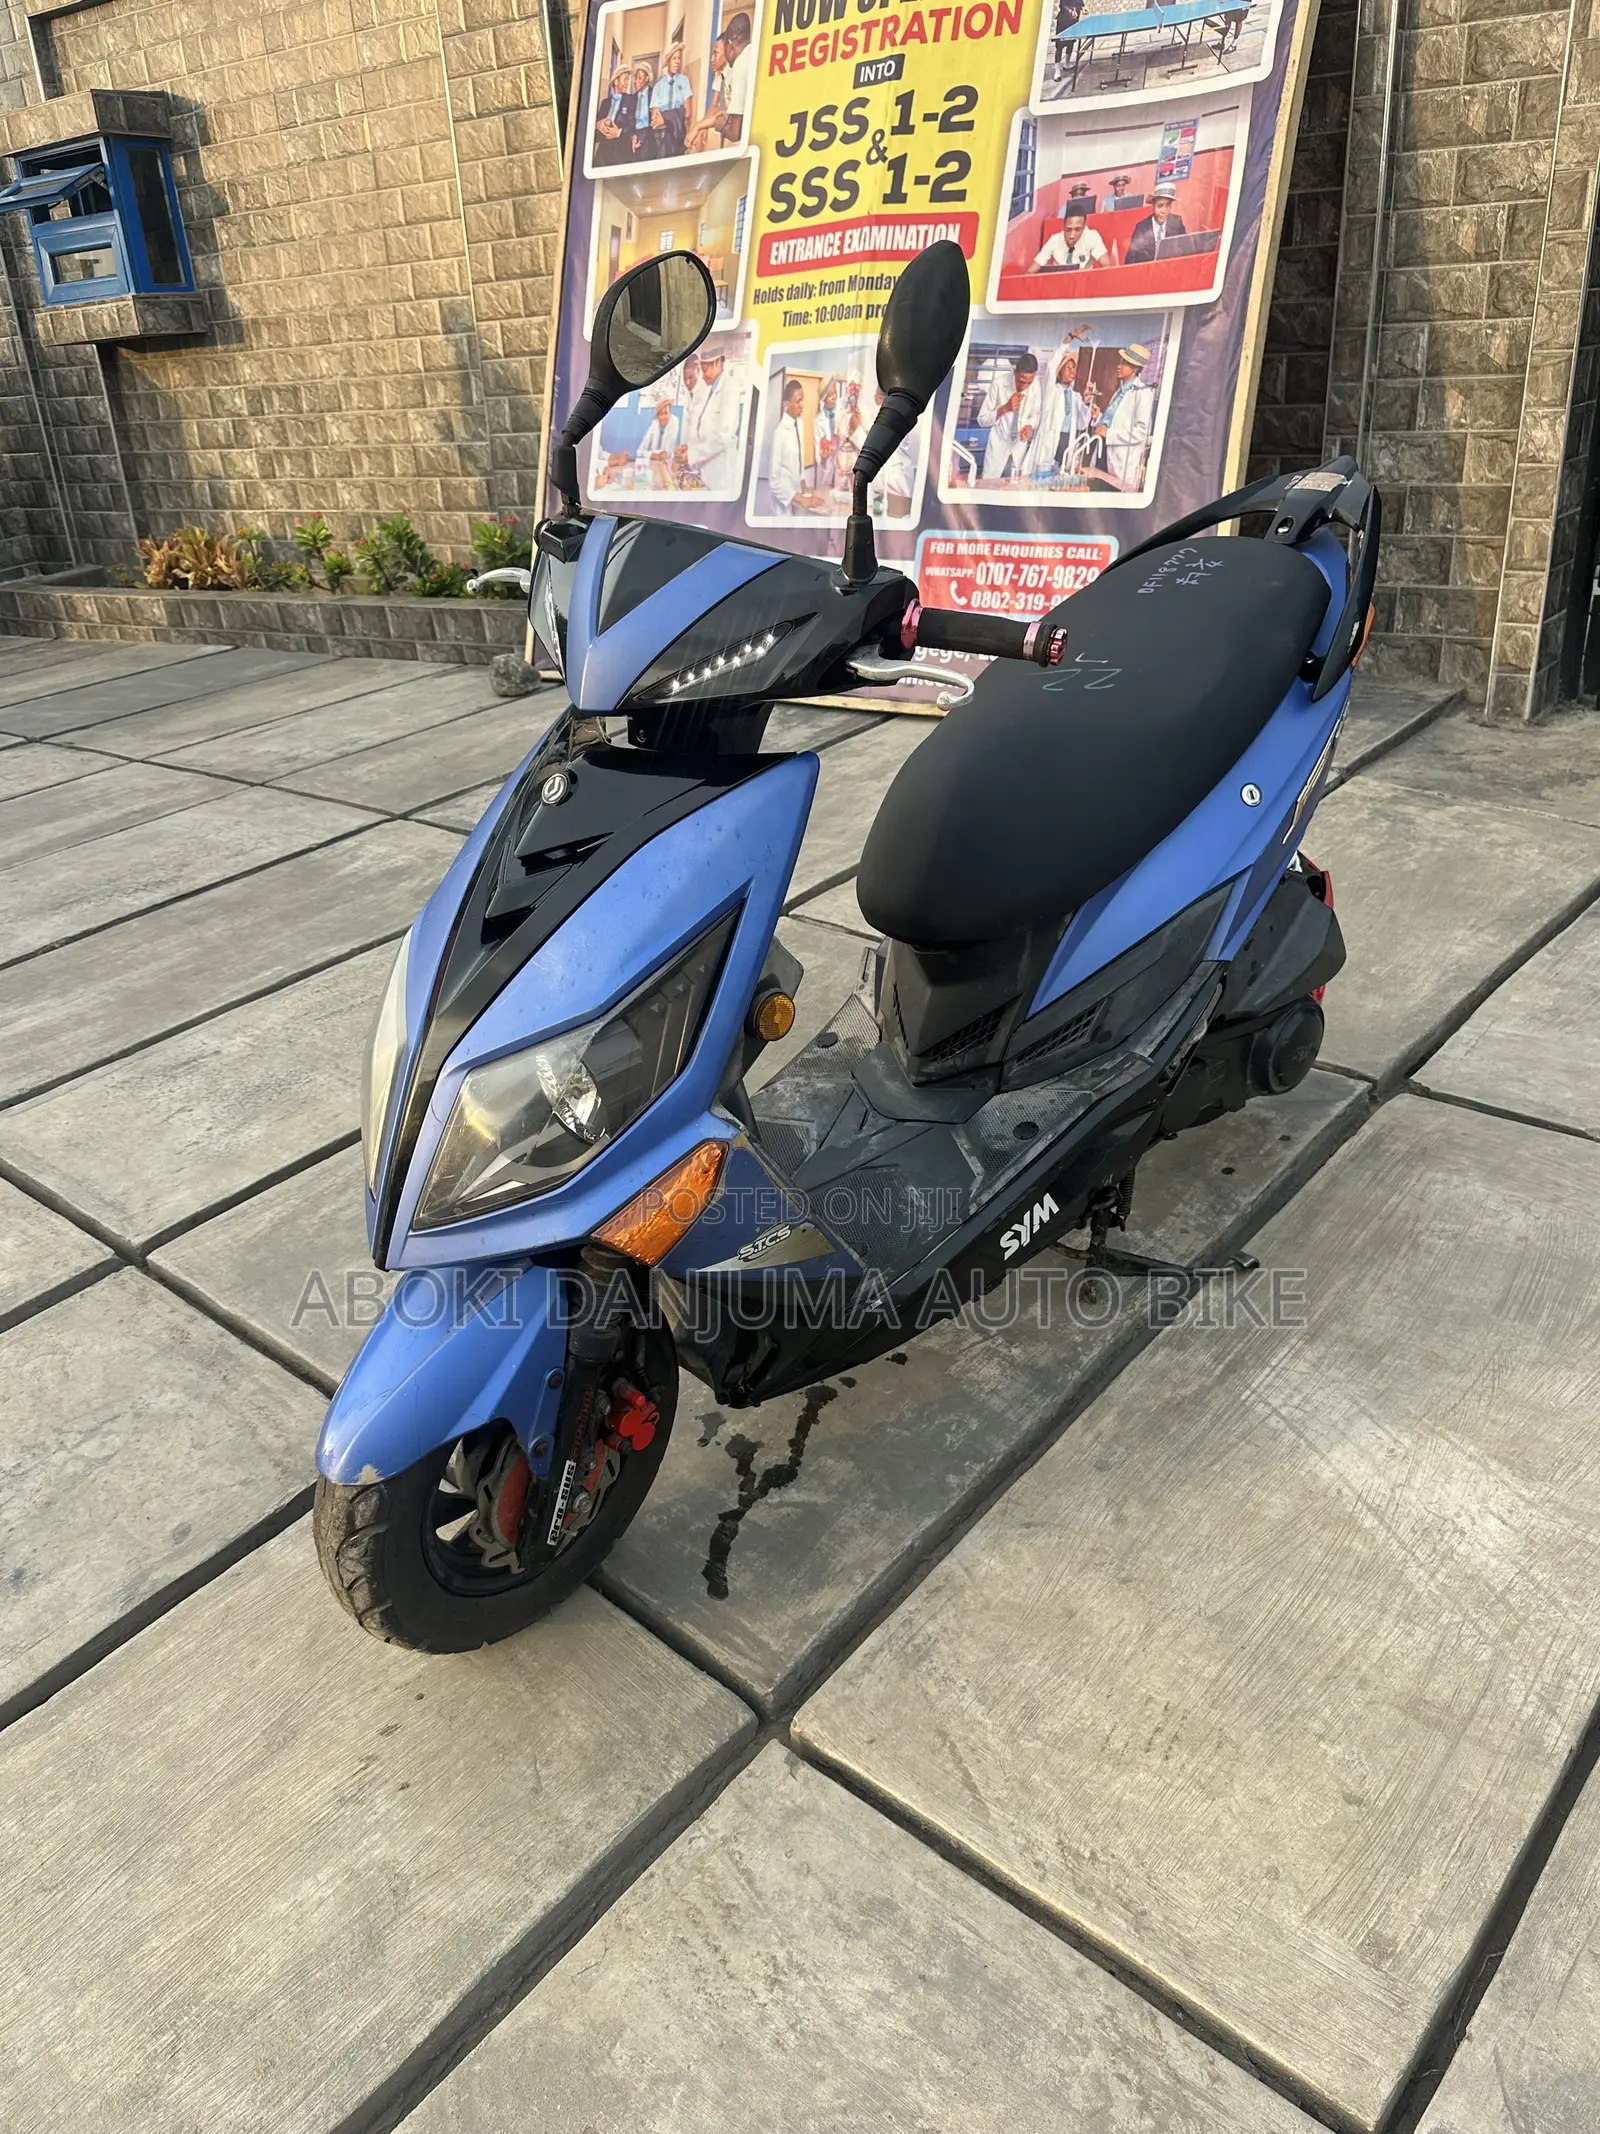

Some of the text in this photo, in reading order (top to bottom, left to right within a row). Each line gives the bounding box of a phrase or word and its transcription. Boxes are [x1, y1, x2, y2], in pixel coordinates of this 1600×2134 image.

[768, 0, 1024, 77] REGISTRATION
[859, 60, 896, 83] INTO
[775, 85, 979, 158] JSS 1-2
[865, 128, 888, 165] &
[767, 150, 972, 224] SSS 1-2
[769, 223, 961, 266] ENTRANCE EXAMINATION
[753, 287, 784, 305] Holds
[786, 283, 817, 301] daily:
[819, 279, 845, 296] from
[783, 309, 813, 328] Time:
[815, 304, 863, 324] 10:00am
[929, 541, 1104, 561] FOR MORE ENQUIRIES CALL:
[925, 562, 1101, 590] WHATSAPP: 0707-767-9829
[999, 1192, 1061, 1261] SYM
